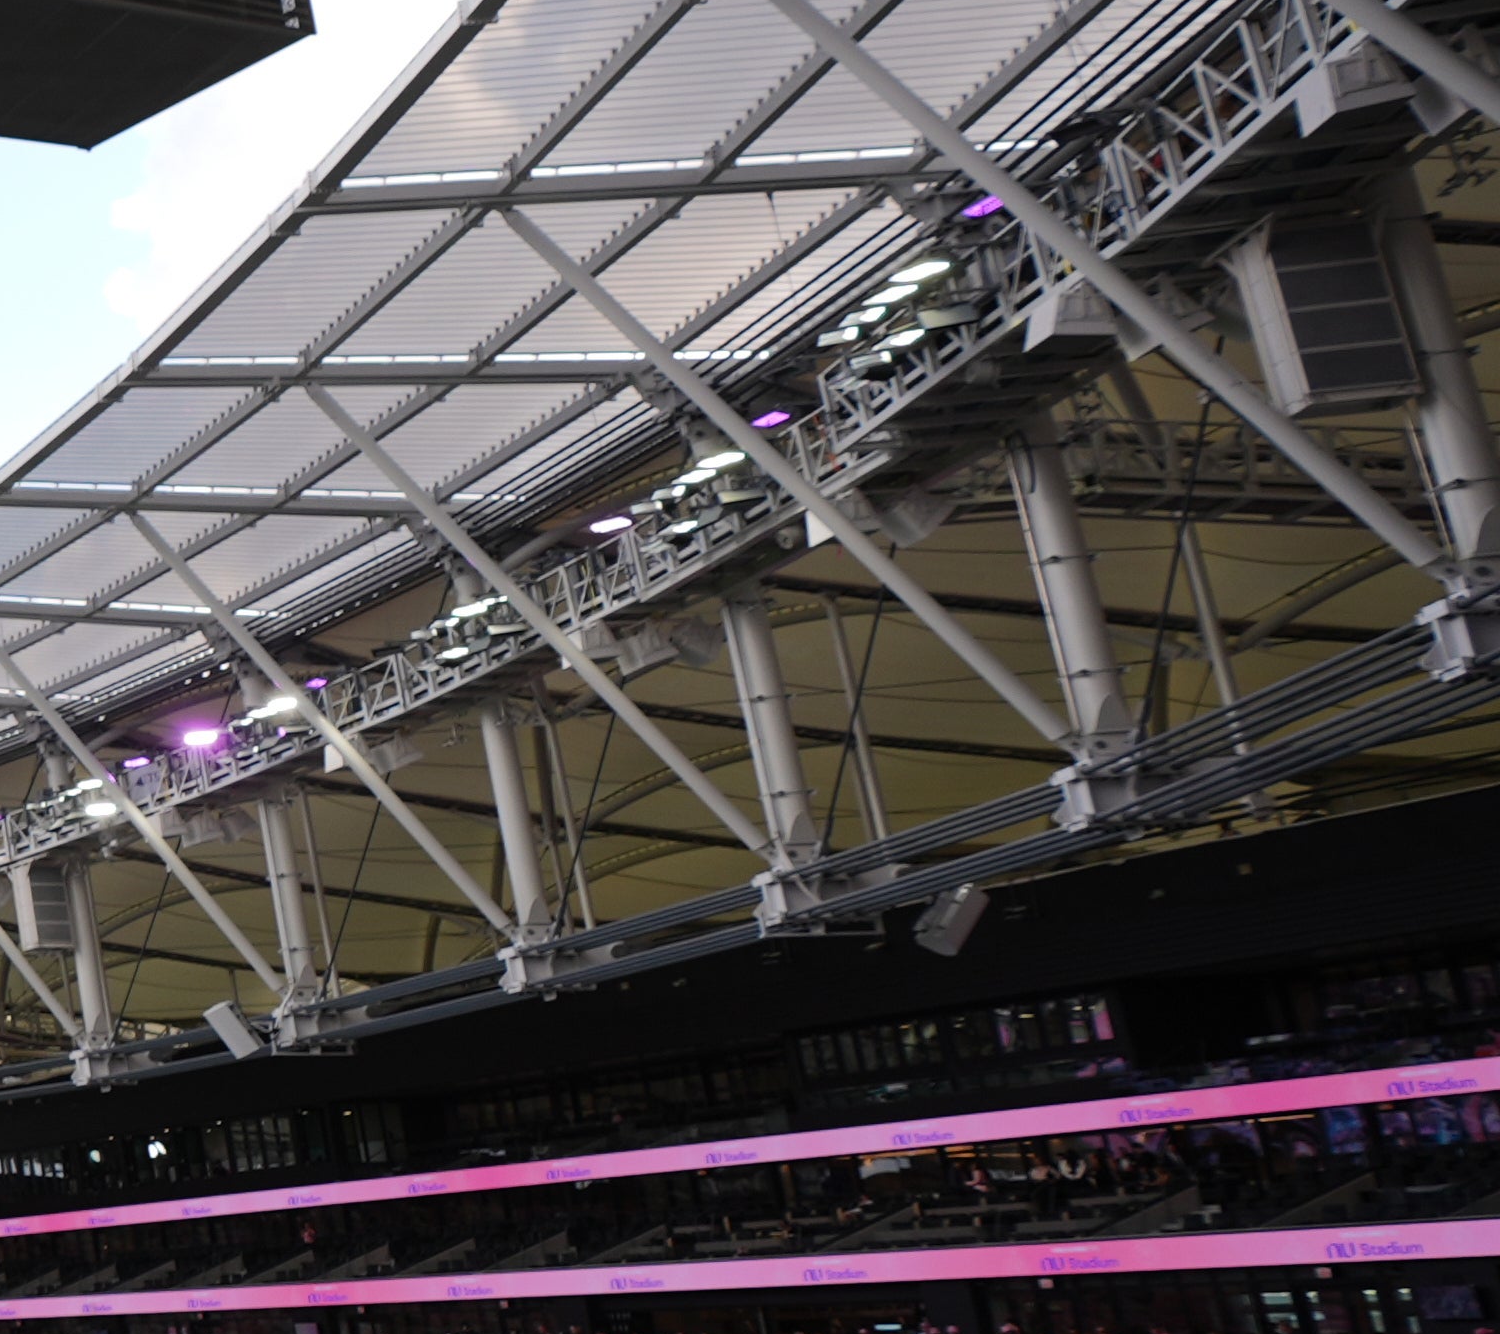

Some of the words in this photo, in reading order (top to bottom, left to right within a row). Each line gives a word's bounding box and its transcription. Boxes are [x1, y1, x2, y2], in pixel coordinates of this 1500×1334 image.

[1420, 1075, 1477, 1093] Stadium
[1145, 1105, 1194, 1120] Stadium
[915, 1130, 954, 1144] Stadium
[724, 1150, 758, 1161] Stadium
[1360, 1240, 1424, 1256] Stadium
[1069, 1257, 1120, 1270] Stadium
[825, 1269, 867, 1280] Stadium
[629, 1278, 663, 1288] Stadium
